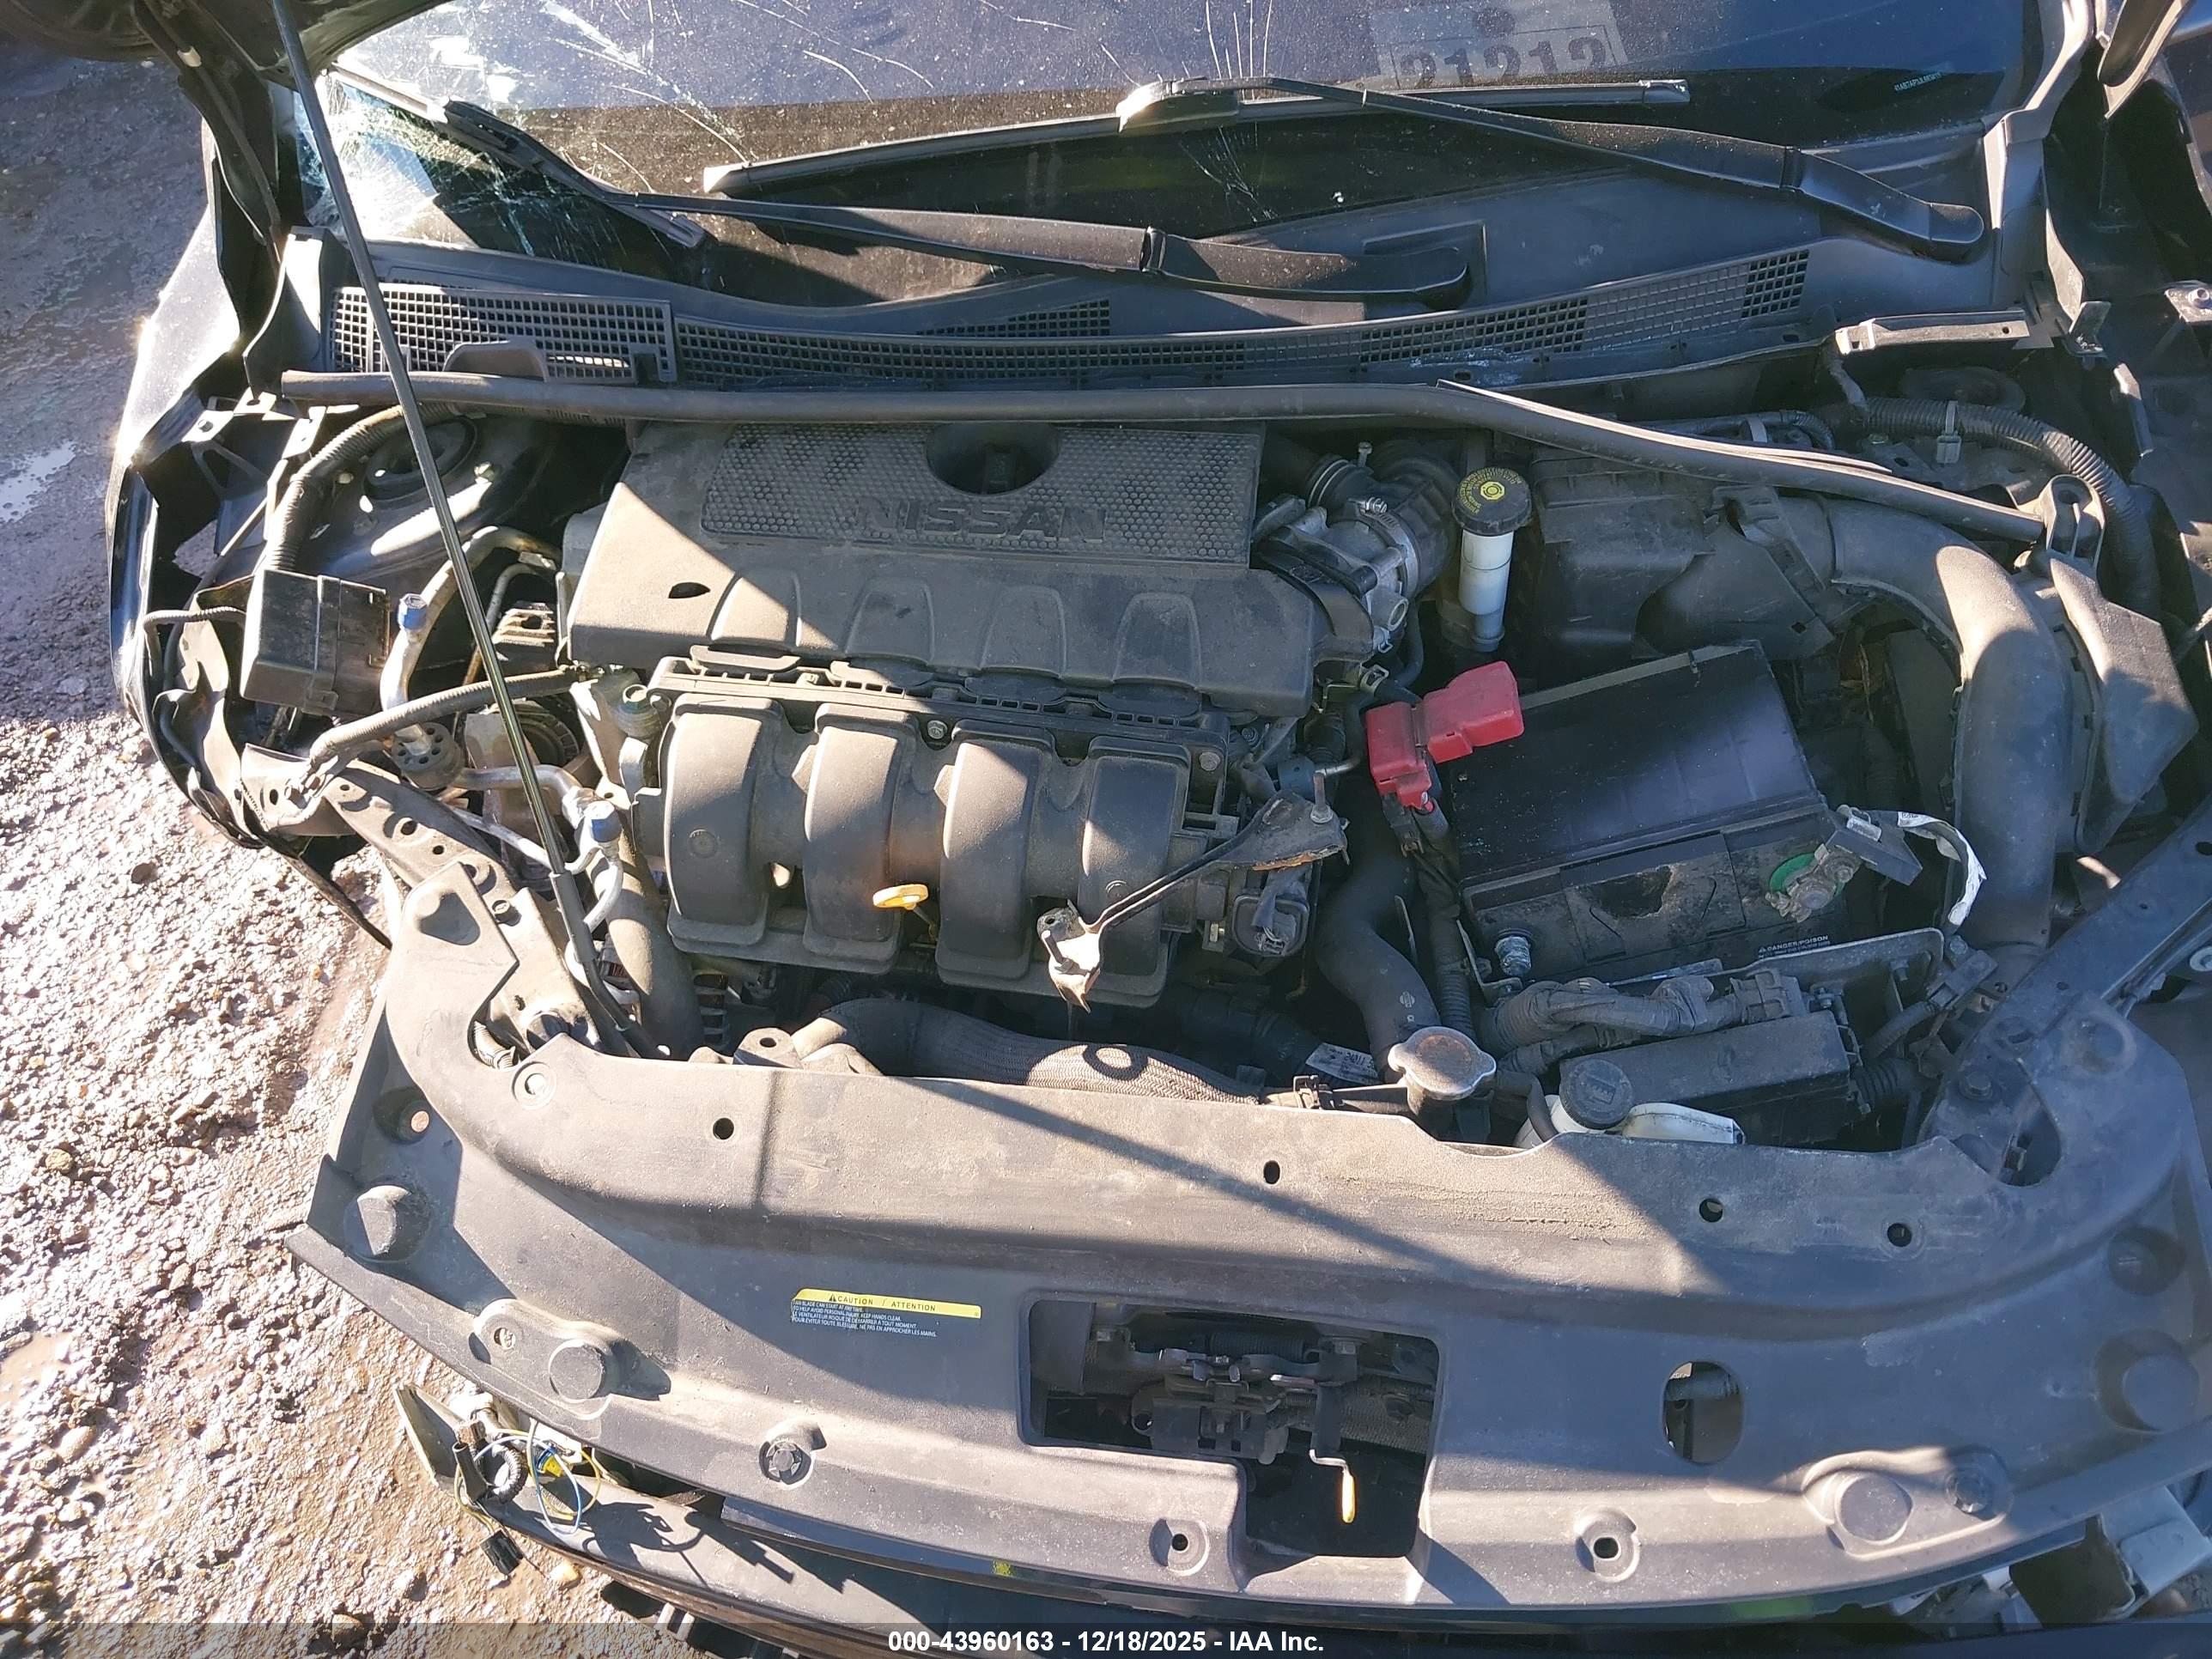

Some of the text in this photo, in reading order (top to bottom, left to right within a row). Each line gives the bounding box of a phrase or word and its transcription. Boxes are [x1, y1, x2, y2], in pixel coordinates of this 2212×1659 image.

[855, 498, 1106, 543] NISSAN
[837, 1296, 873, 1305] CAUTION
[890, 1301, 936, 1311] ATTENTION
